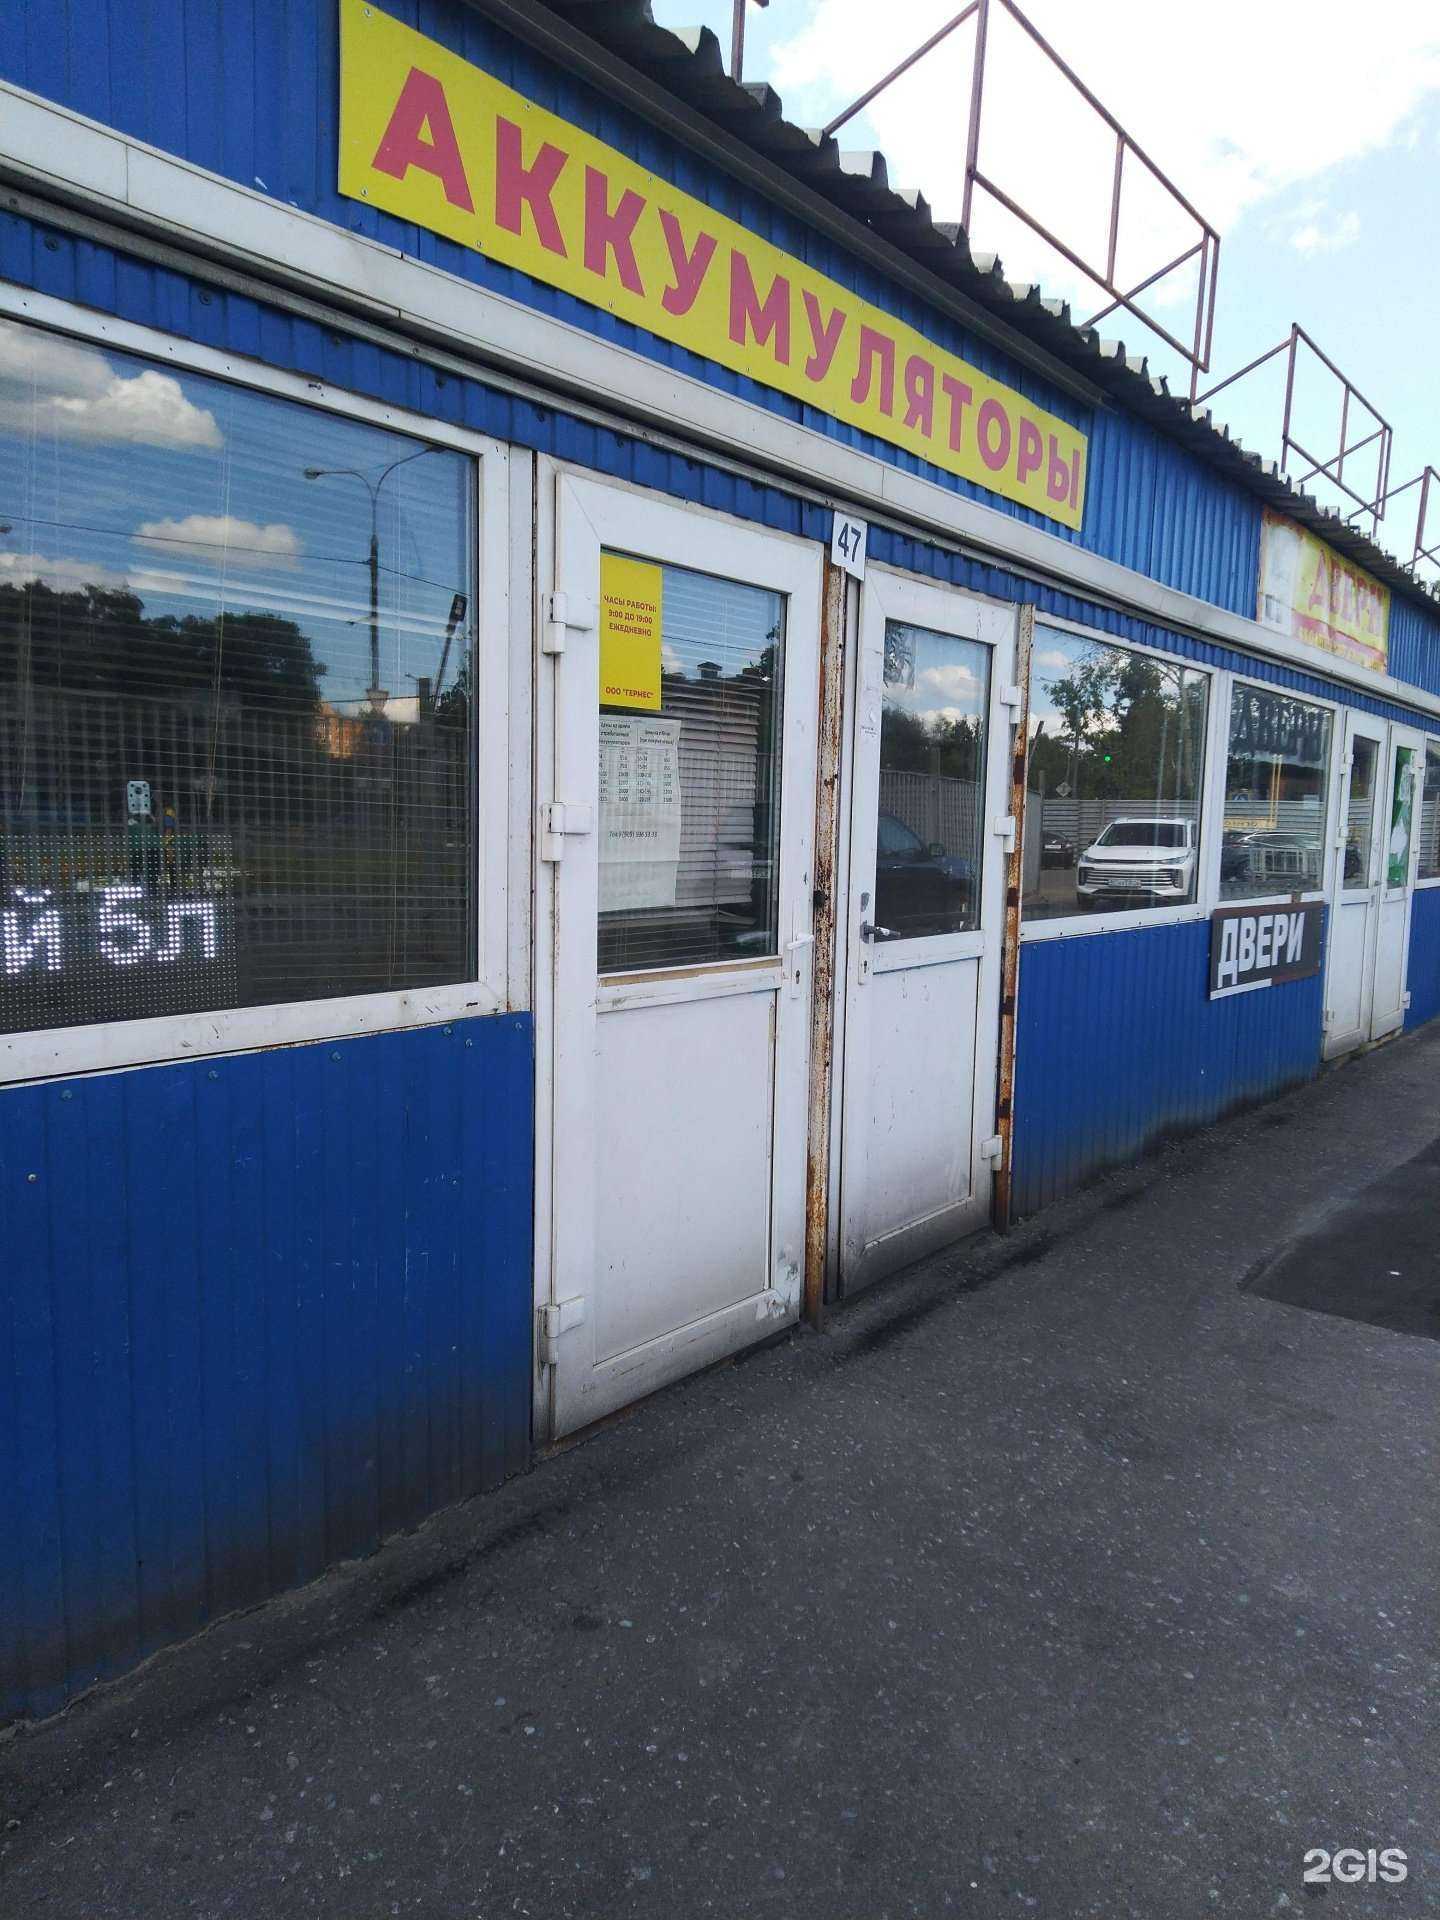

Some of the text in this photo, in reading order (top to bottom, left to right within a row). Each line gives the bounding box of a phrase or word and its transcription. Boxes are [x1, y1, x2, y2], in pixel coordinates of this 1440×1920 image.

[371, 66, 1081, 511] АККУМУЛЯТОРЫ
[838, 522, 861, 562] 47
[604, 595, 625, 606] ЧАСЫ
[608, 609, 652, 624] 9:00 ДО 19:00
[610, 622, 651, 637] ЕЖЕДНЕВНО
[606, 687, 621, 695] ООО
[1217, 912, 1305, 988] ДВЕРИ
